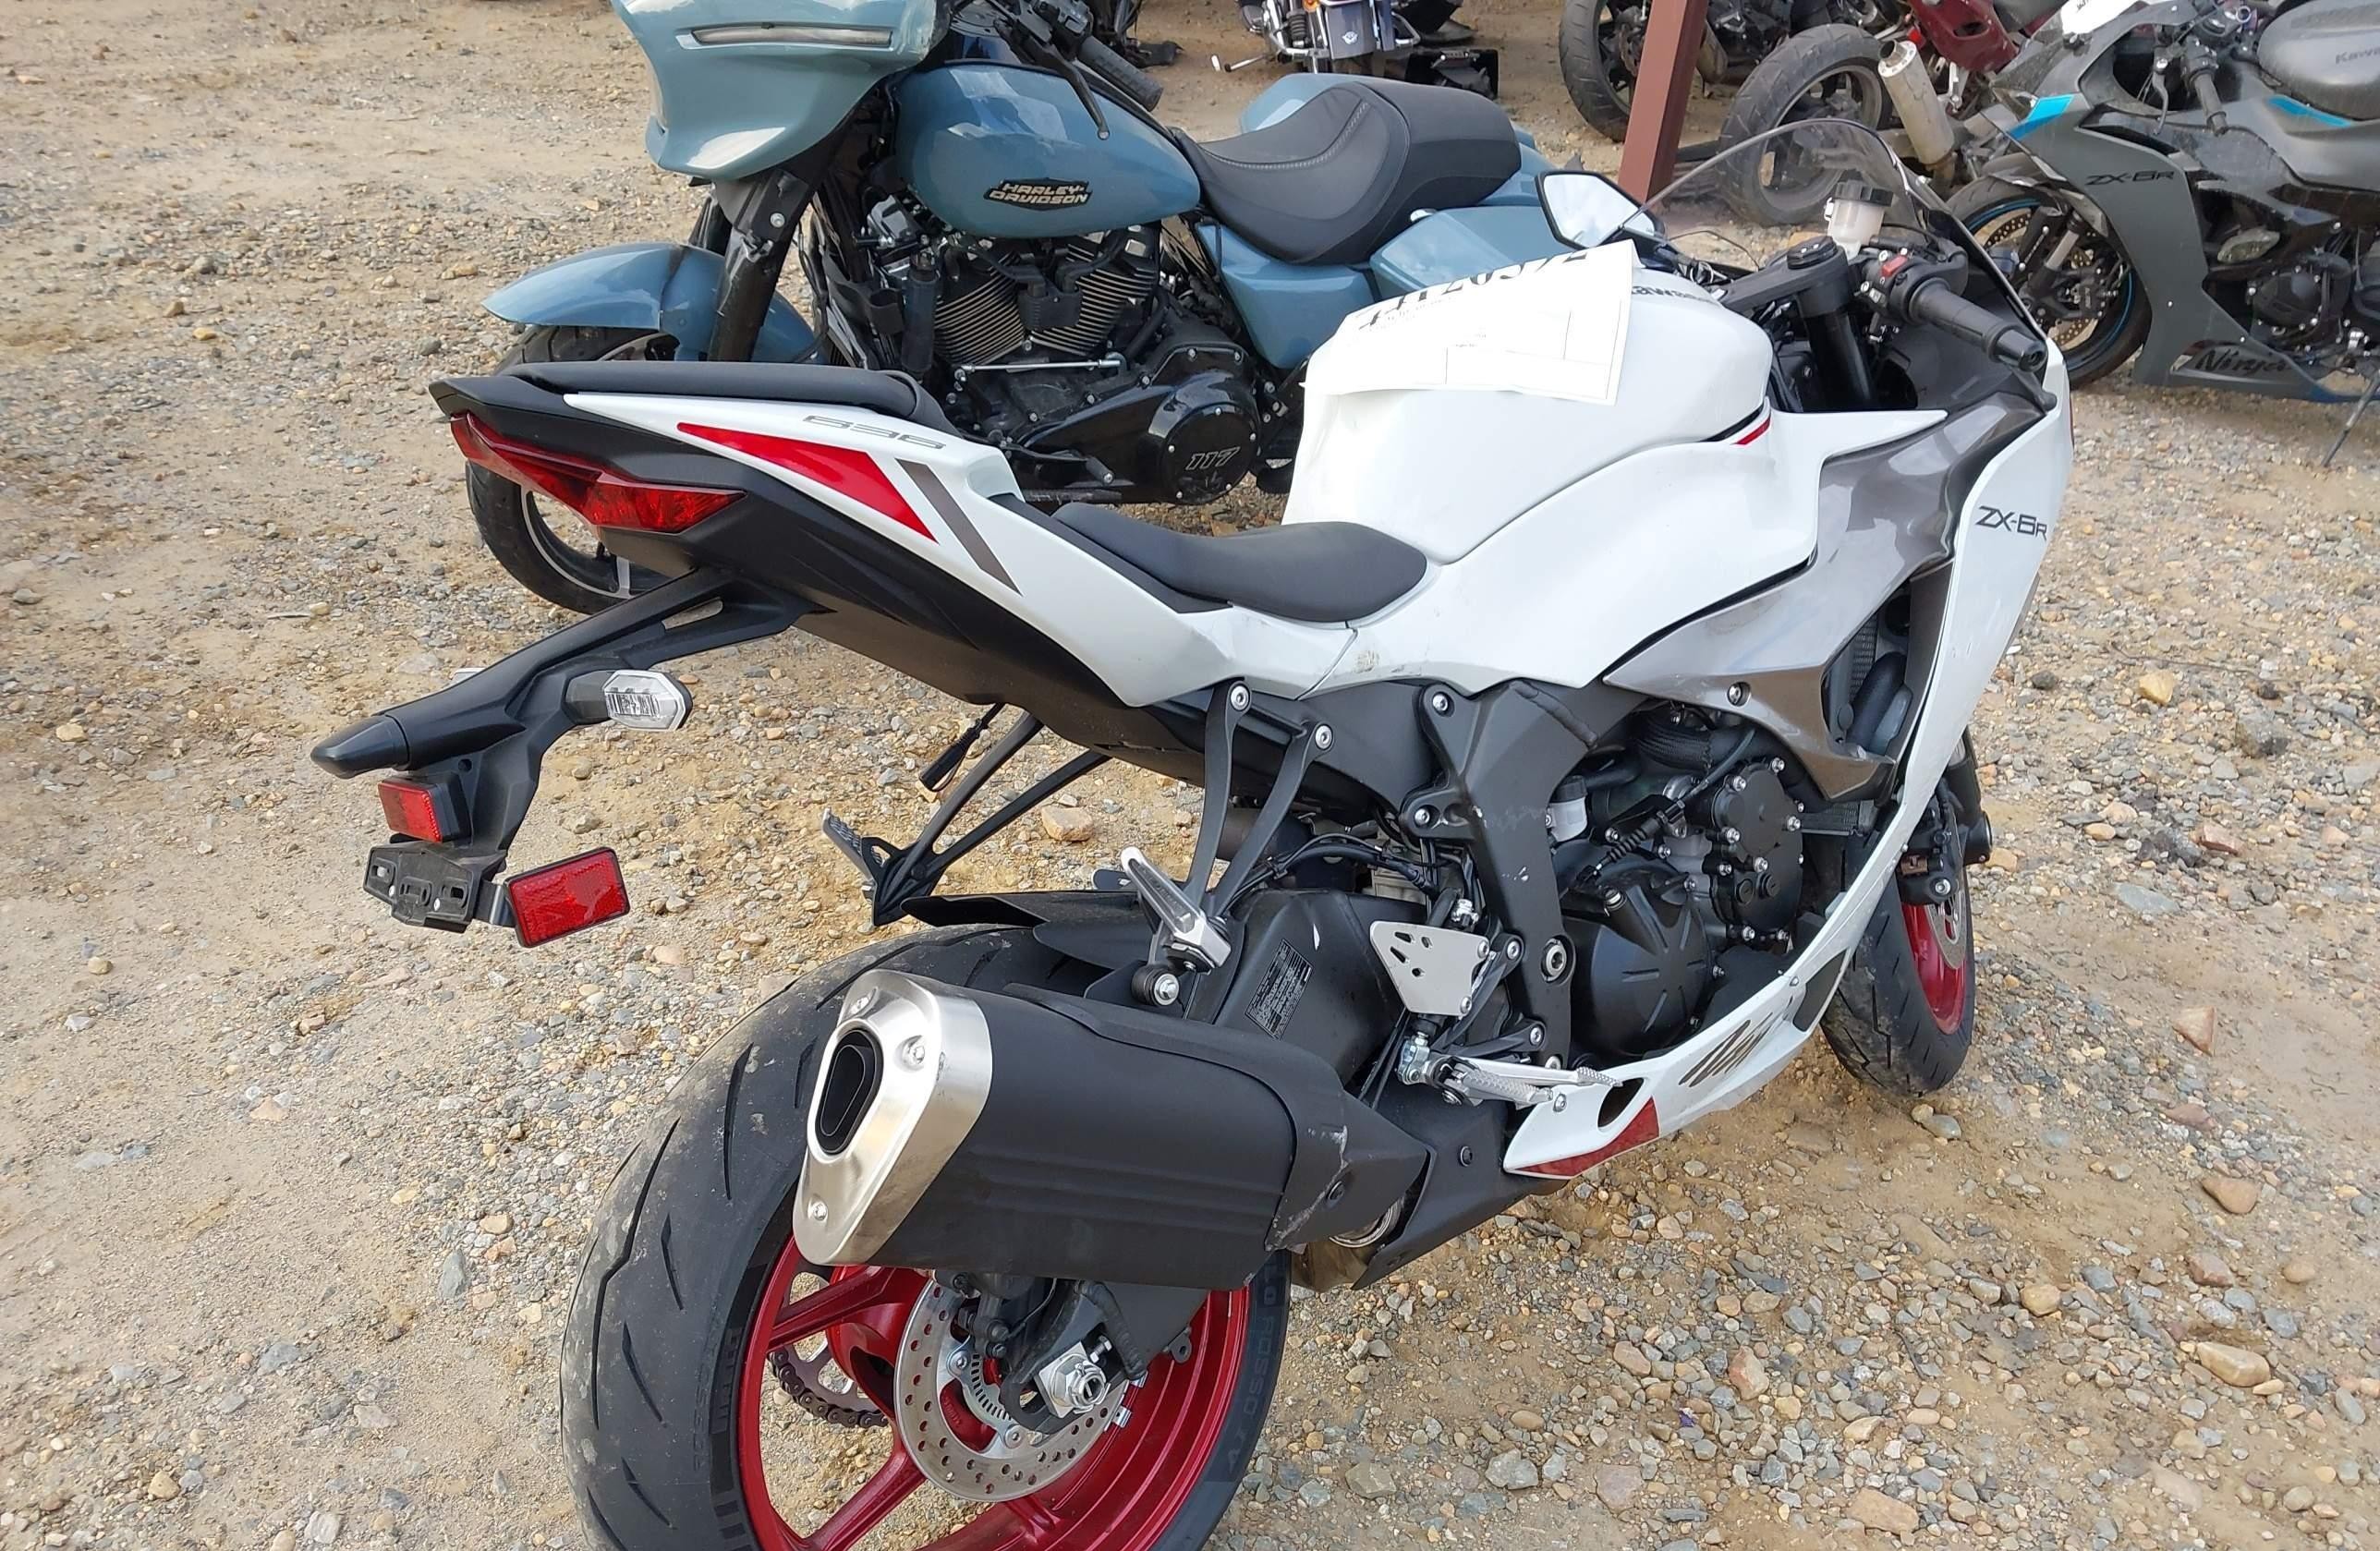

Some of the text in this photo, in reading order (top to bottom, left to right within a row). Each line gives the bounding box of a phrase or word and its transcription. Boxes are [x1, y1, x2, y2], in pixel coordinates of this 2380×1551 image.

[2084, 170, 2175, 186] ZX-6R
[989, 190, 1088, 204] DAVIDSON
[802, 415, 947, 450] 636
[1185, 446, 1241, 470] 117
[1975, 505, 2047, 541] ZX-6R
